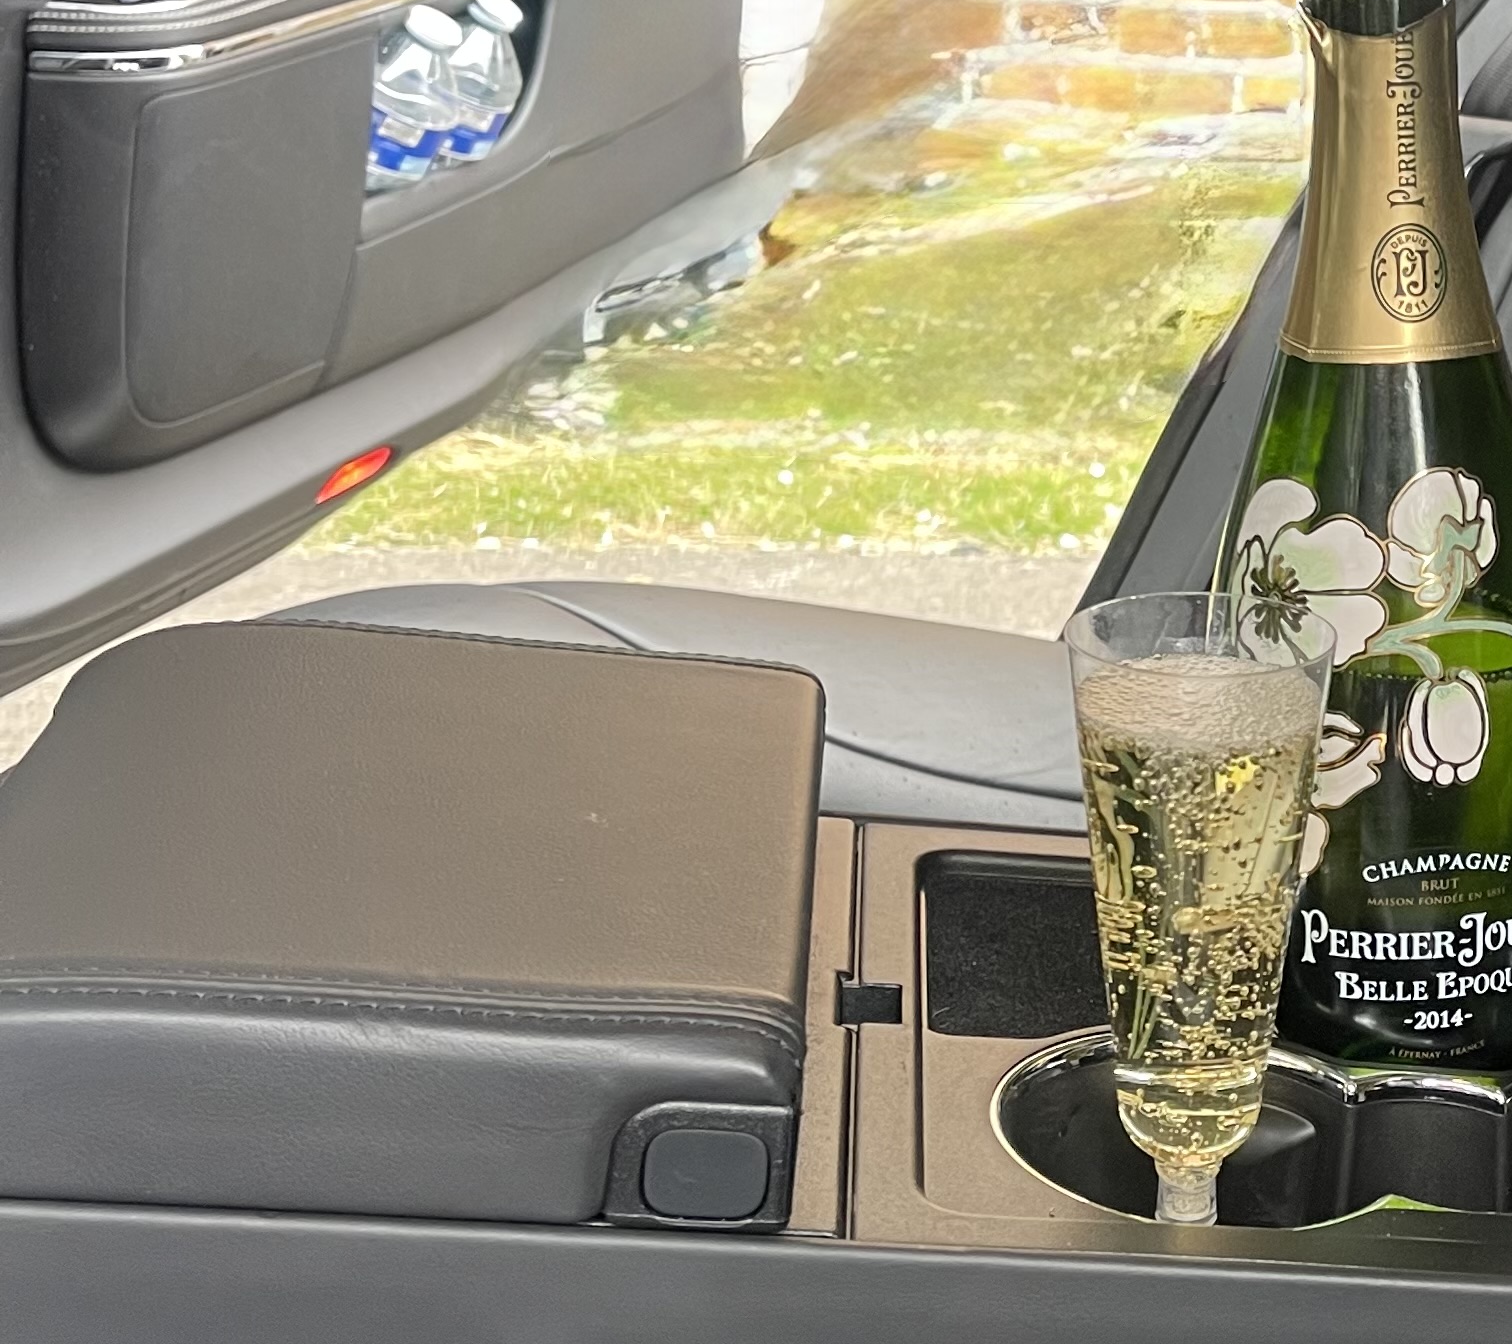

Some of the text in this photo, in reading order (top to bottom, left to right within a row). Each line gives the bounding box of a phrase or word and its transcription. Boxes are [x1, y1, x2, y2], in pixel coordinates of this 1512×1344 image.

[1390, 234, 1428, 249] DEPUIS
[1398, 299, 1429, 313] 1811
[1361, 852, 1512, 884] CHAMPAGNE
[1420, 877, 1460, 892] BRUT
[1366, 897, 1414, 907] MAISON
[1468, 891, 1483, 902] EN
[1334, 970, 1429, 1002] BELLE
